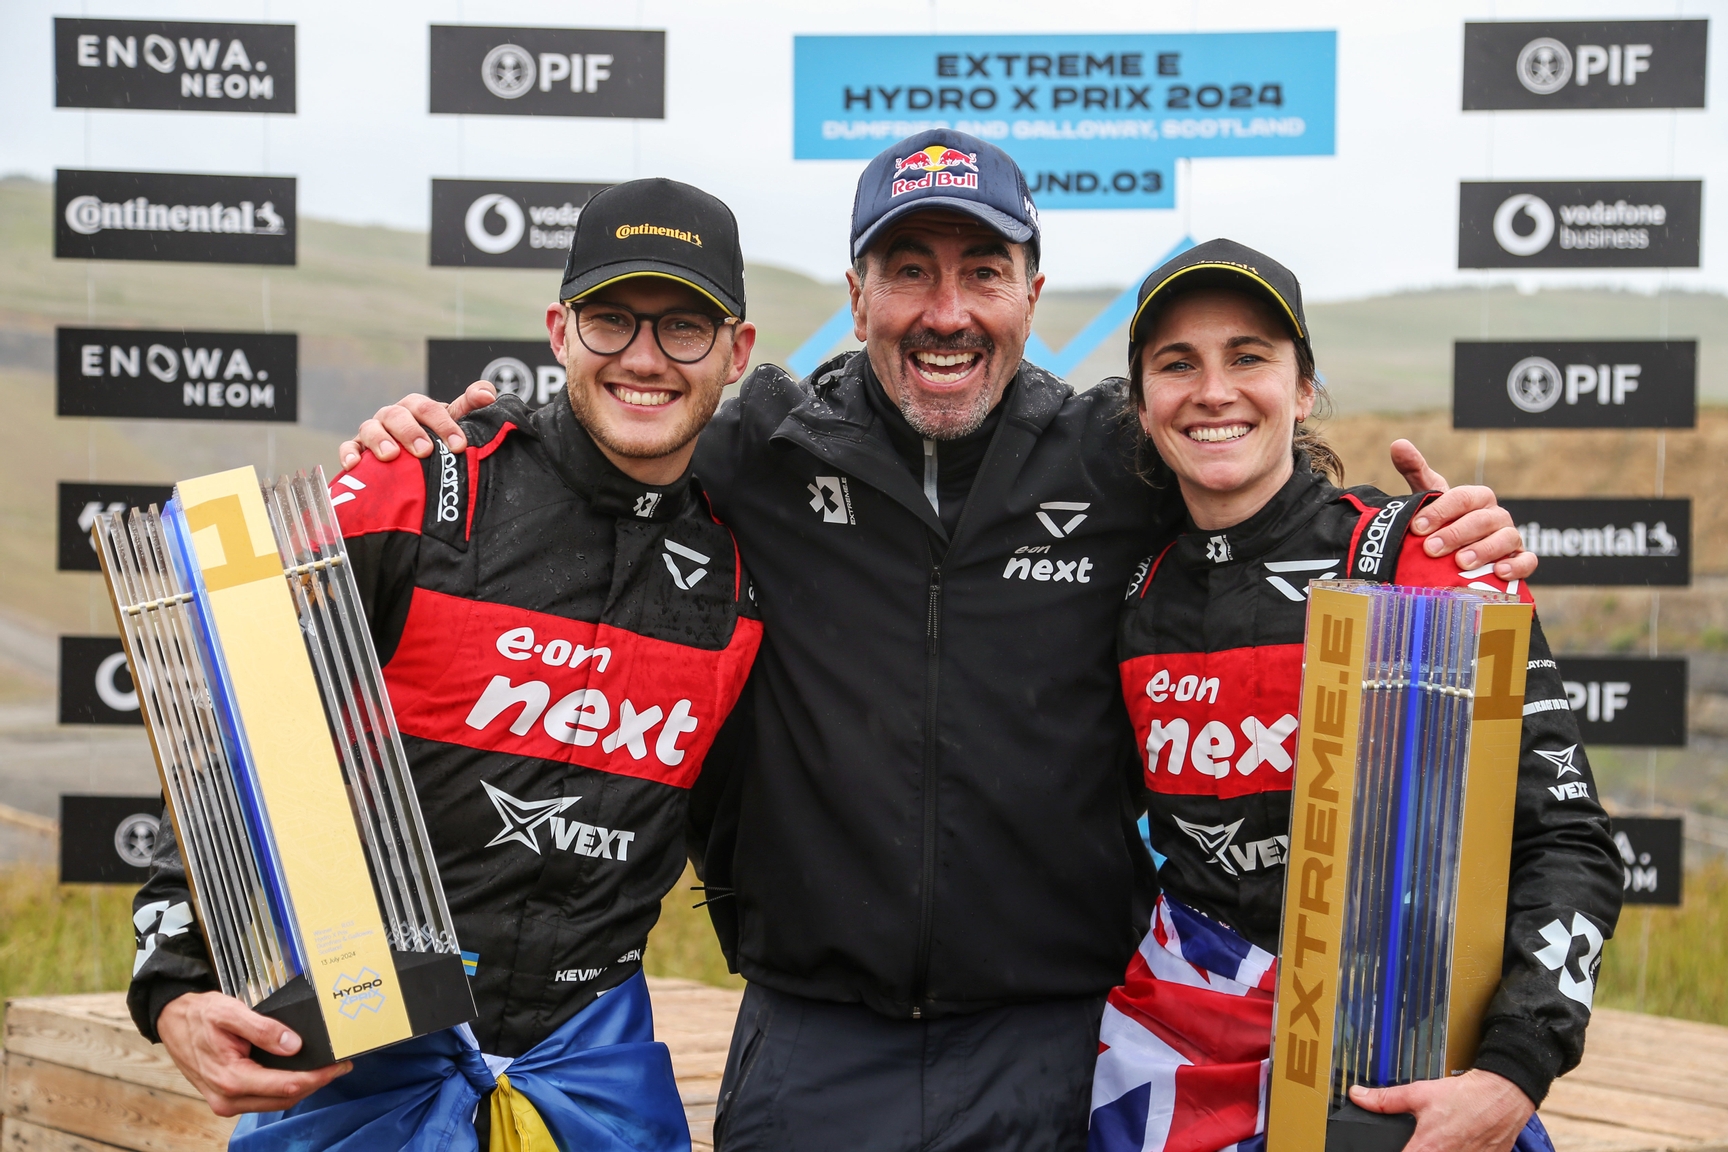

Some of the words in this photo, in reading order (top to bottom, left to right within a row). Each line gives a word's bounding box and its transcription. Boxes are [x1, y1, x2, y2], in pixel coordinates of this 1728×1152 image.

[77, 34, 267, 73] ENOWA.
[935, 53, 1144, 78] EXTREME
[1155, 52, 1182, 77] E
[1575, 44, 1654, 86] PIF
[180, 73, 273, 100] NEOM
[538, 53, 611, 92] PIF
[843, 87, 999, 112] HYDRO
[1012, 87, 1039, 111] X
[1052, 86, 1152, 111] PRIX
[1165, 84, 1285, 110] 2024
[1011, 119, 1159, 142] GALLOWAY,
[1160, 117, 1307, 139] SCOTLAND
[892, 172, 933, 198] Red
[935, 172, 979, 190] Bull
[1024, 171, 1162, 194] UND.03
[65, 194, 256, 235] Continental
[529, 202, 581, 227] voda
[1559, 200, 1667, 227] vodafone
[529, 226, 577, 250] busi
[615, 223, 692, 243] Continental
[1559, 226, 1650, 250] business
[80, 343, 269, 383] ENOWA.
[183, 382, 275, 408] NEOM
[1565, 364, 1642, 405] PIF
[184, 493, 285, 593] 1
[1357, 499, 1409, 575] sparco
[1517, 521, 1648, 558] tinental
[1002, 556, 1094, 584] next
[1473, 629, 1523, 721] 1
[1562, 681, 1632, 722] PIF
[464, 675, 699, 767] next
[1145, 713, 1299, 780] nex
[1547, 781, 1590, 802] VEXT
[550, 816, 635, 862] VEXT
[1228, 834, 1289, 872] VEX
[1285, 613, 1354, 1089] EXTREME.E
[333, 979, 383, 999] HYDRO
[555, 968, 602, 981] KEVIN
